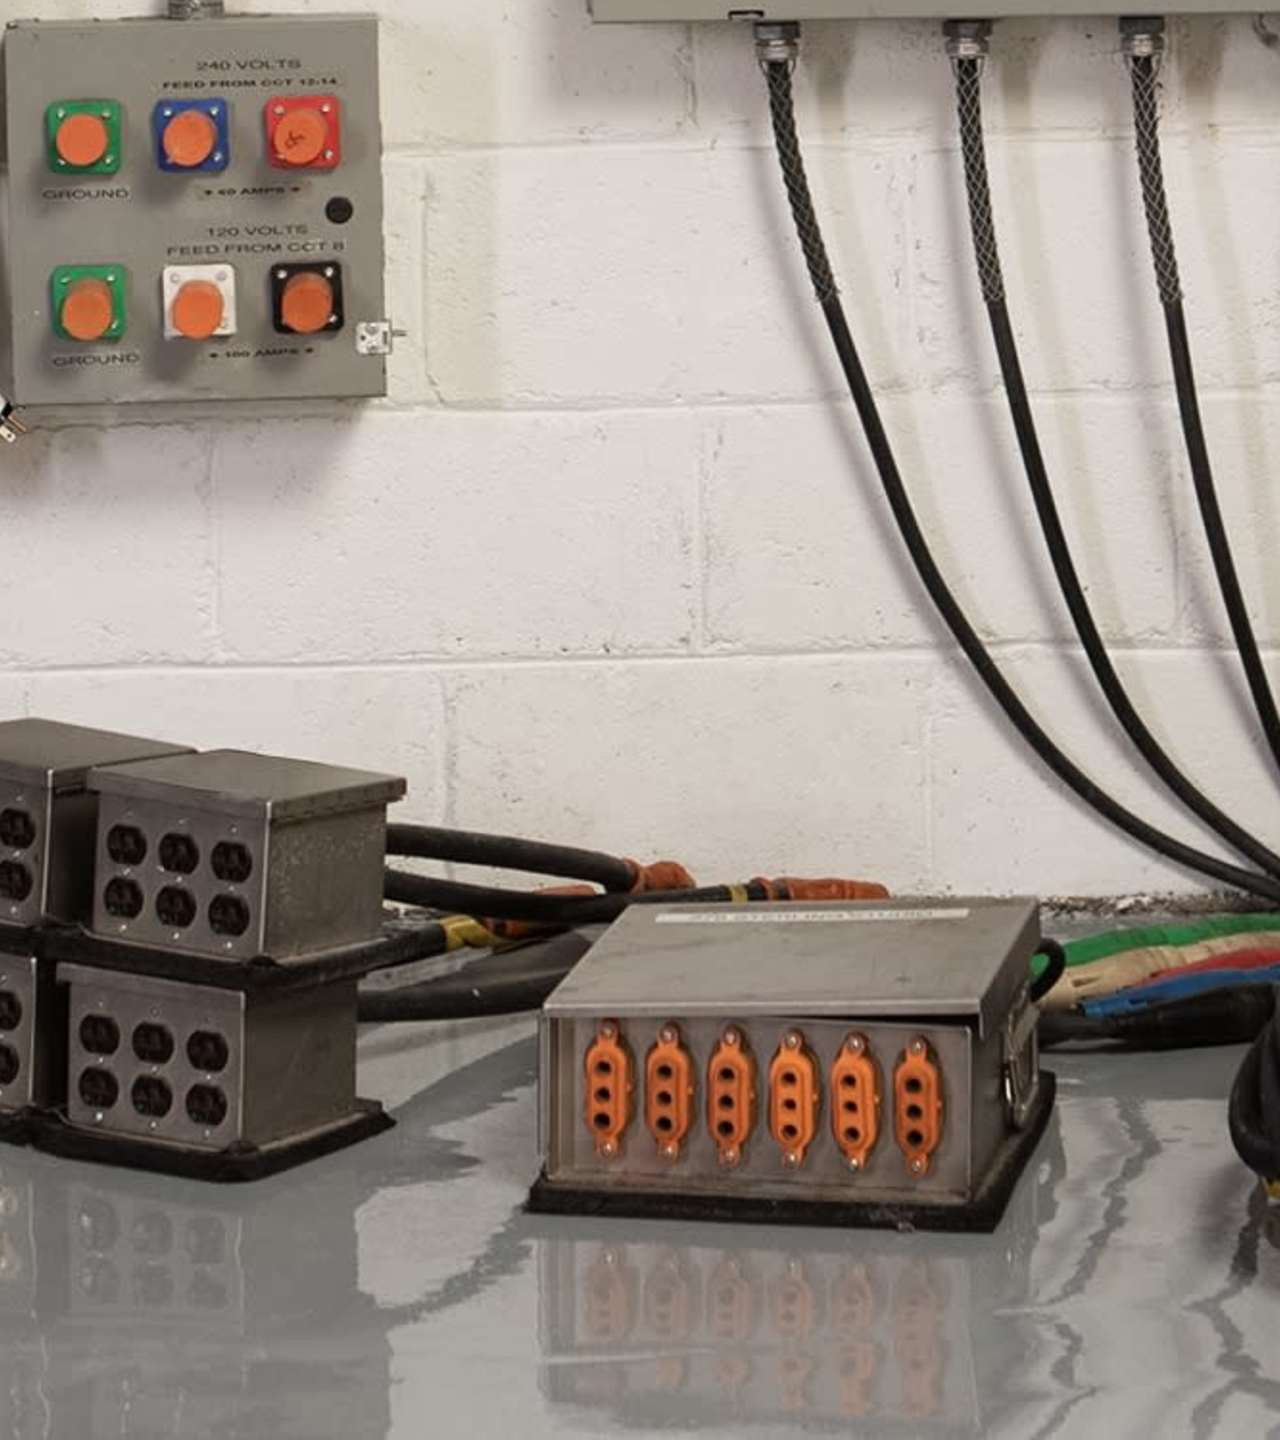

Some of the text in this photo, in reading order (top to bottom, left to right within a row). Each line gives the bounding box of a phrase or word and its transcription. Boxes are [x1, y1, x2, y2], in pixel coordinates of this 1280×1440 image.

[196, 58, 301, 71] 240 VOLTS
[163, 79, 205, 89] FEED
[209, 79, 256, 88] FROM
[41, 187, 129, 200] GROUND
[207, 225, 308, 237] 120 VOLTS
[166, 245, 220, 256] FEED
[223, 243, 282, 254] FROM
[52, 353, 139, 366] GROUND
